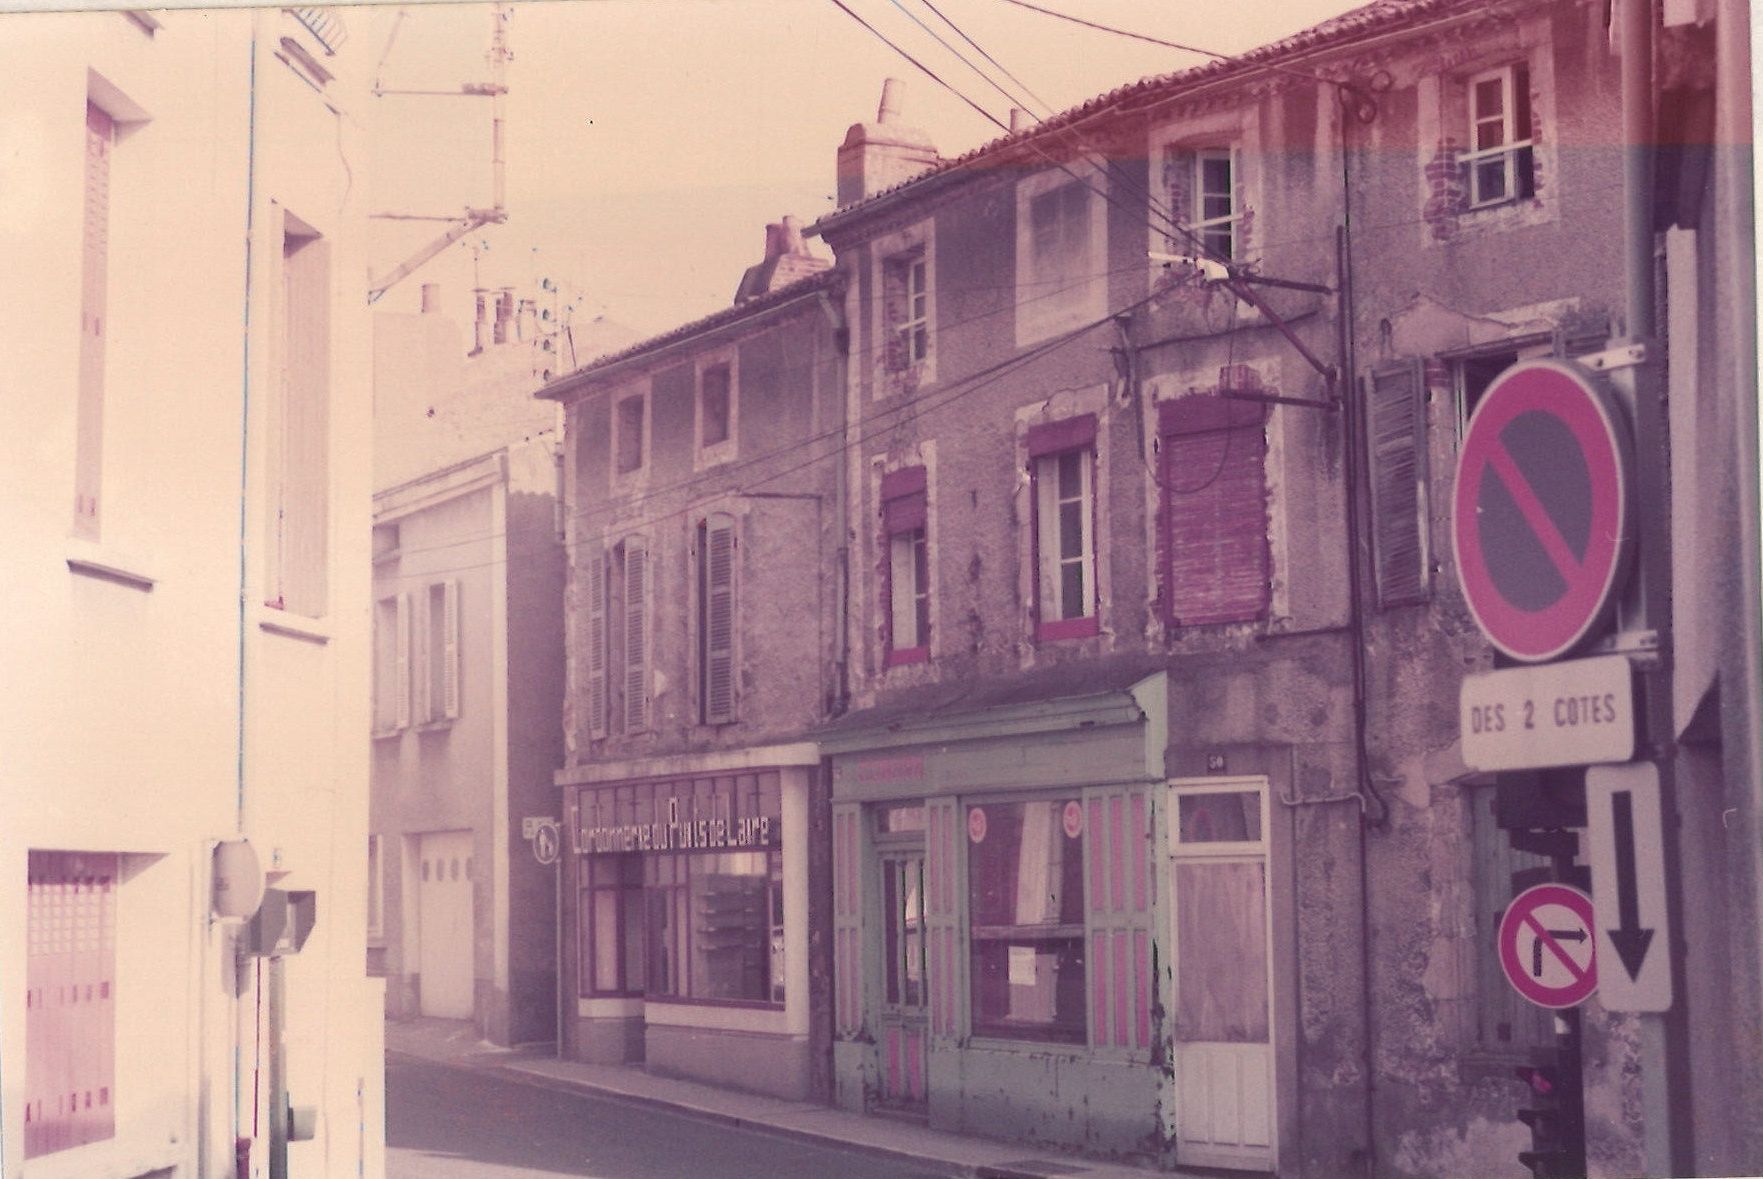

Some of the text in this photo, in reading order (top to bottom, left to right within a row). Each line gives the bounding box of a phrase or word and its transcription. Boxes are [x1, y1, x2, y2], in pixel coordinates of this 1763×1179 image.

[1471, 694, 1615, 734] DES 2 COTES
